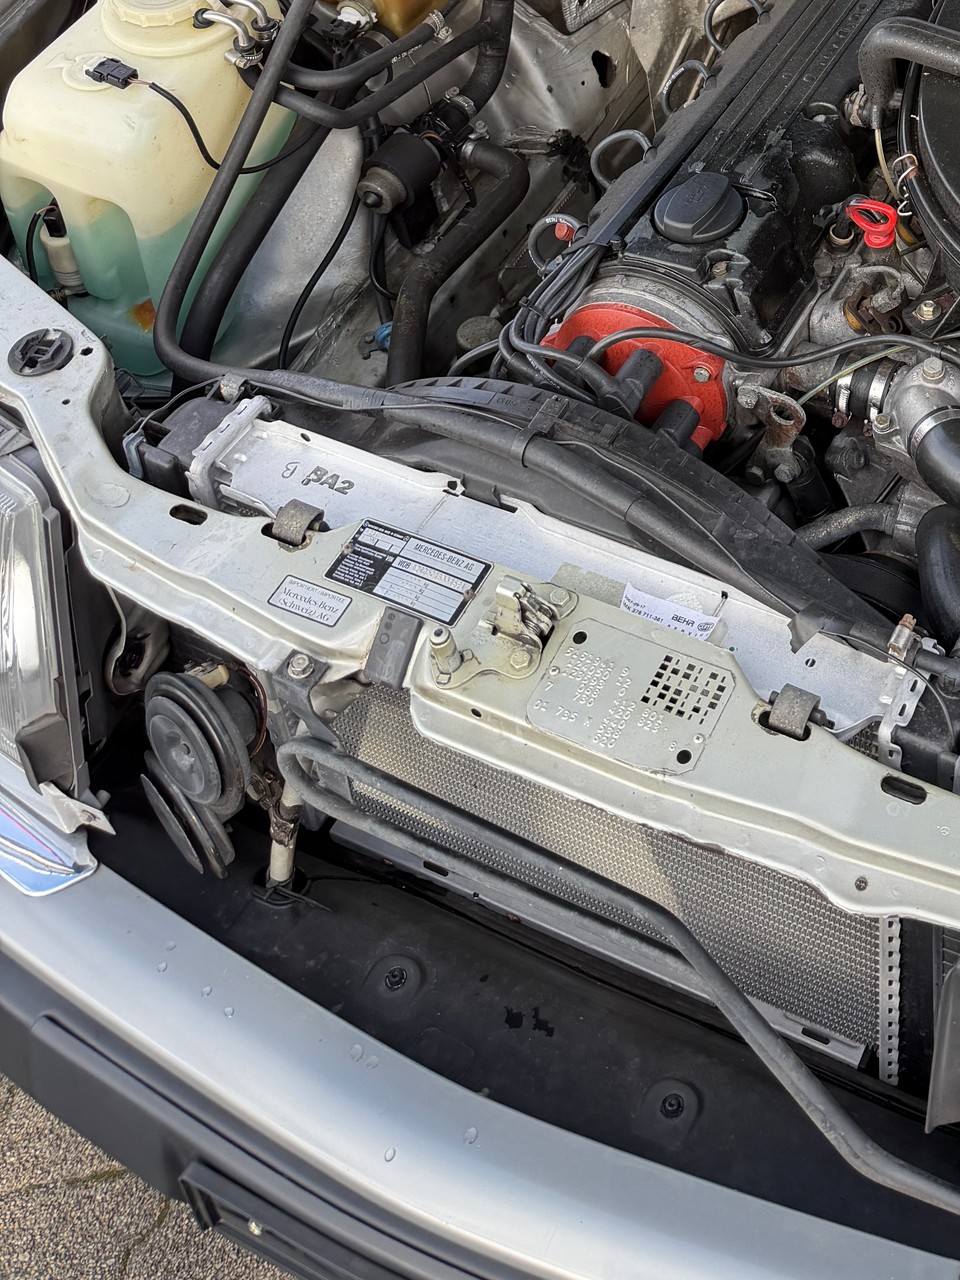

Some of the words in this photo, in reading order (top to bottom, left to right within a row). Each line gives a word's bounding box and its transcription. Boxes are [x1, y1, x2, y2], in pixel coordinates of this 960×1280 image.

[413, 544, 464, 566] MERCEDES-BENZ
[464, 562, 474, 570] AG
[278, 597, 316, 615] (Schweiz)
[317, 611, 330, 621] AG
[281, 587, 339, 613] Mercedes-Benz
[671, 613, 695, 628] BEHR
